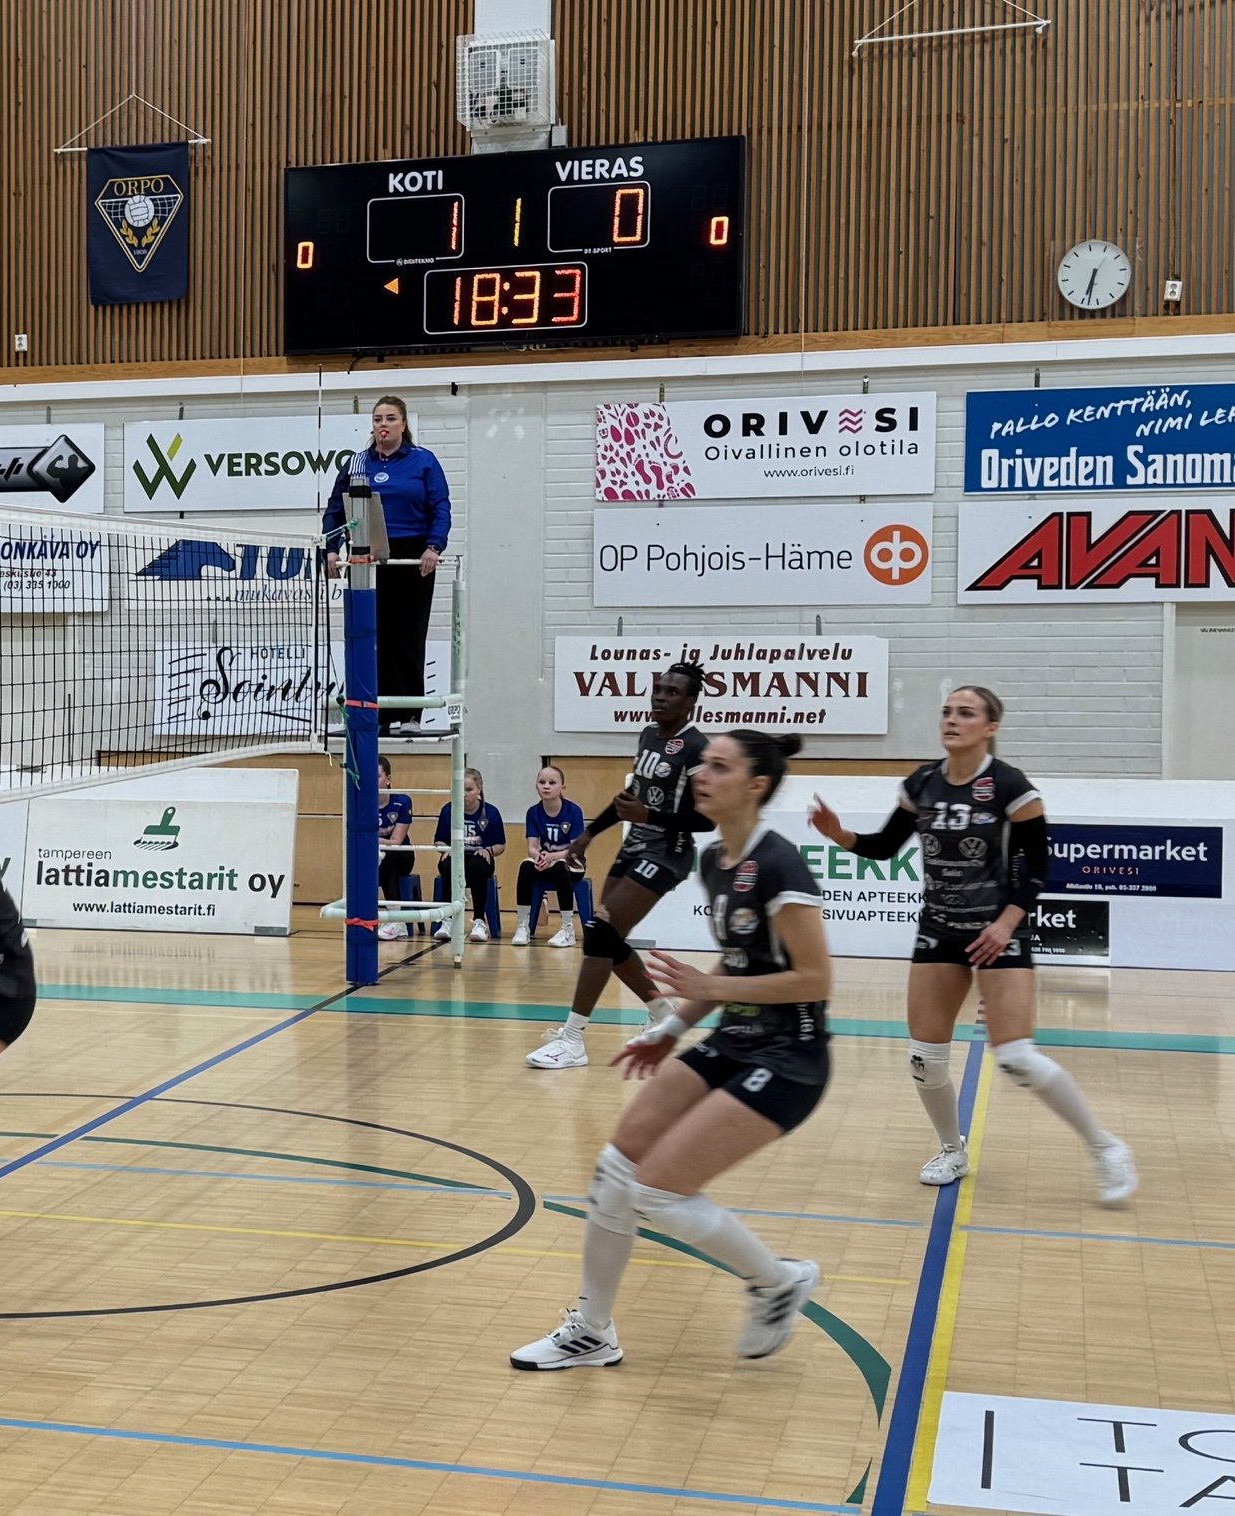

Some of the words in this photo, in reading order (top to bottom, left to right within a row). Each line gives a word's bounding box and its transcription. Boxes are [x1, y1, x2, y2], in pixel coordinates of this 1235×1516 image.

[388, 169, 444, 193] KOTI
[555, 156, 645, 182] VIERAS
[113, 177, 164, 196] ORPO
[450, 201, 459, 250] 1
[513, 197, 522, 247] 1
[611, 187, 645, 243] 0
[709, 215, 730, 245] 0
[296, 241, 314, 269] 0
[453, 268, 582, 326] 18:33
[989, 412, 1060, 439] PALLO
[1065, 387, 1193, 426] KENTTÄÄN,
[1135, 413, 1193, 438] NIMI
[704, 443, 827, 461] Oivallinen
[839, 439, 919, 457] olotila
[763, 466, 855, 479] www.orivesi.fi
[980, 446, 1114, 489] Oriveden
[1126, 445, 1235, 486] Sanom
[76, 540, 100, 560] OY
[599, 545, 638, 572] OP
[646, 542, 853, 577] Pohjois-Häme
[47, 580, 71, 589] 1000
[251, 648, 305, 660] HOTELLI
[589, 644, 671, 661] Lounas-
[680, 643, 701, 664] ja
[709, 642, 853, 664] Juhlapalvelu
[573, 671, 869, 698] VALSMANNI
[634, 749, 661, 779] 10
[930, 801, 972, 831] 13
[546, 828, 559, 843] 11
[38, 847, 112, 861] tampereen
[36, 861, 238, 891] lattiamestarit
[248, 873, 285, 899] oy
[633, 859, 659, 879] 10
[1082, 865, 1139, 875] ORIVESI
[72, 900, 216, 917] www.lattiamestarit.fi
[822, 909, 922, 923] SIVUAPTEEK
[741, 1067, 774, 1093] 8
